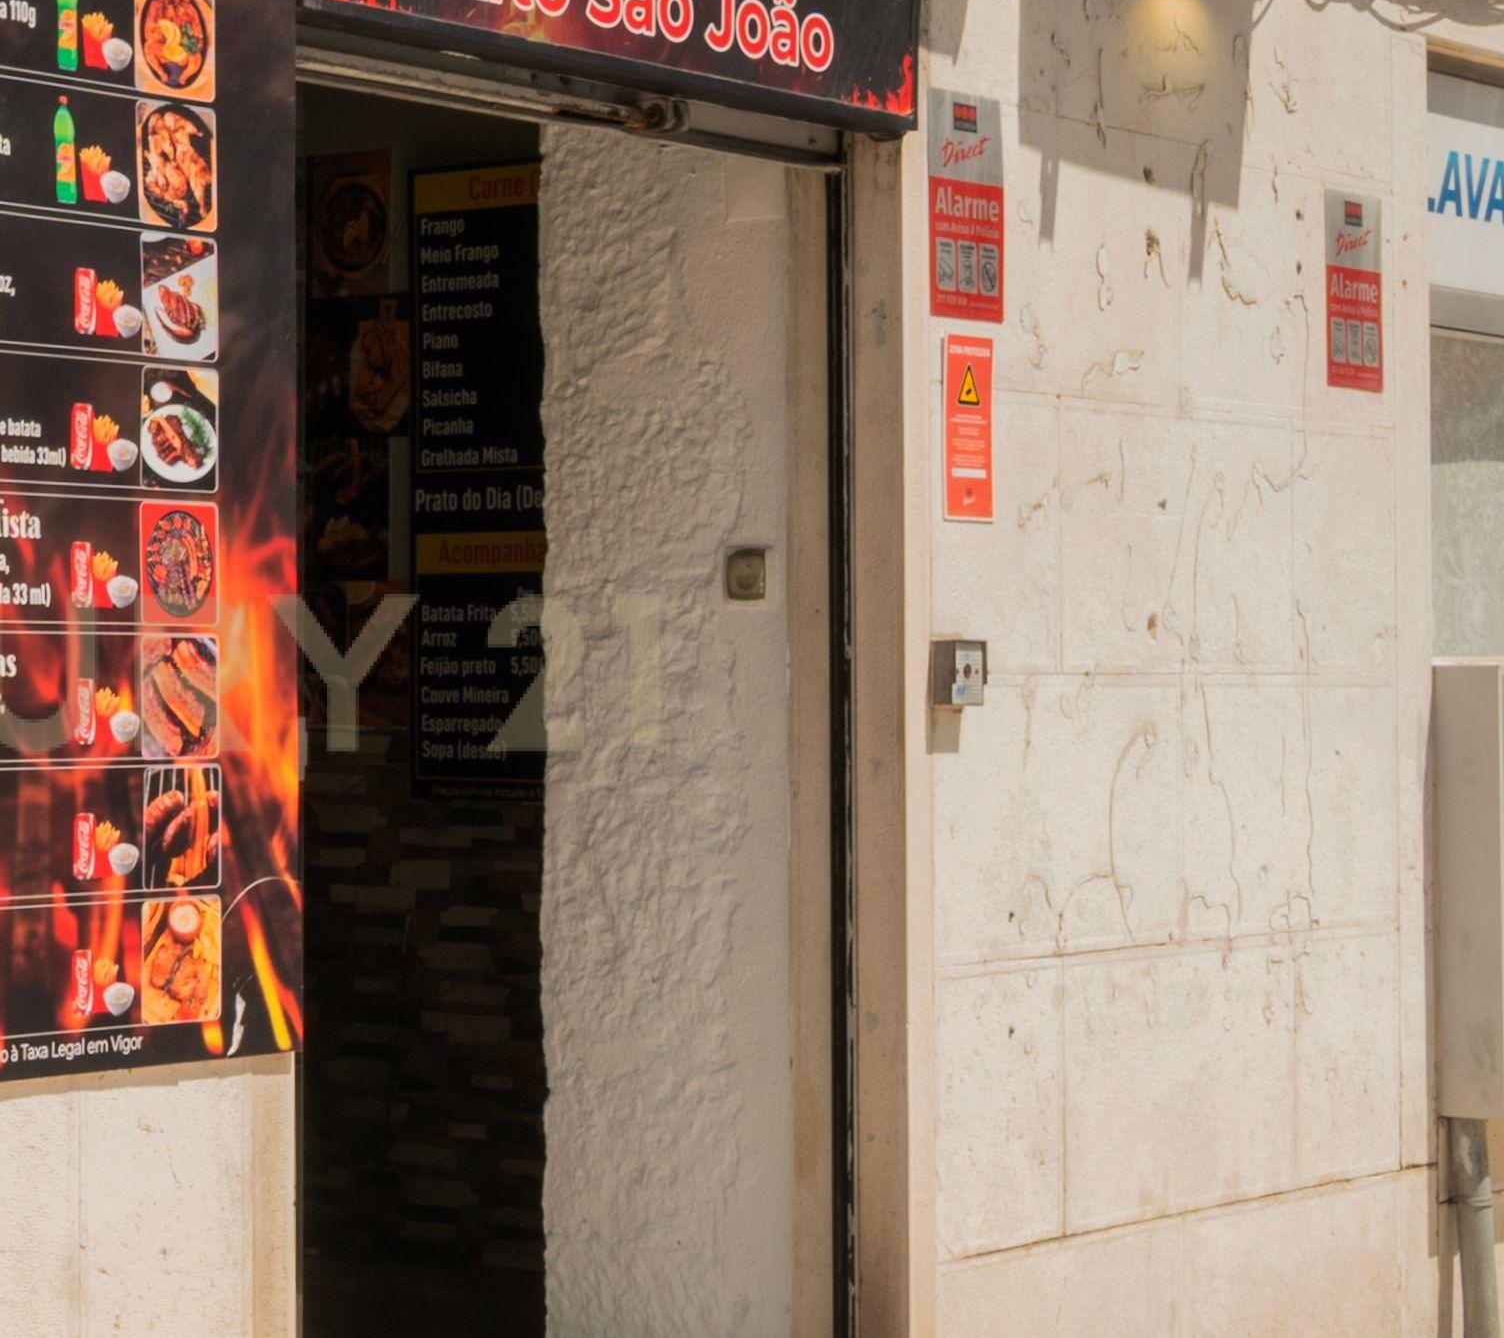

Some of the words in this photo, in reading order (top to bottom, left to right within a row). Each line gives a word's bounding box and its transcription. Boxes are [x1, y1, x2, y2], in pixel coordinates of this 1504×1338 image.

[10, 0, 36, 29] 110g
[469, 174, 525, 201] Carne
[934, 186, 1000, 223] Alarme
[421, 217, 465, 237] Frango
[421, 246, 451, 265] Meio
[455, 245, 499, 264] Frango
[422, 272, 499, 294] Entremeada
[1330, 274, 1378, 303] Alarme
[422, 302, 492, 322] Entrecosto
[423, 333, 459, 350] Piano
[423, 362, 463, 379] Bifana
[422, 388, 477, 407] Salsicha
[423, 417, 473, 437] Picanha
[421, 448, 479, 468] Grelhada
[482, 446, 518, 464] Mista
[416, 489, 457, 512] Prato
[462, 489, 481, 510] do
[486, 486, 511, 509] Dia
[421, 605, 465, 623] Batata
[421, 630, 457, 647] Arroz
[420, 657, 459, 678] Feijão
[462, 659, 496, 678] preto
[421, 686, 459, 704] Couve
[463, 685, 509, 703] Mineira
[421, 741, 453, 760] Sopa
[11, 1045, 17, 1062] à
[21, 1043, 48, 1060] Taxa
[51, 1037, 85, 1060] Legal
[87, 1039, 108, 1055] em
[110, 1035, 143, 1055] Vigor
